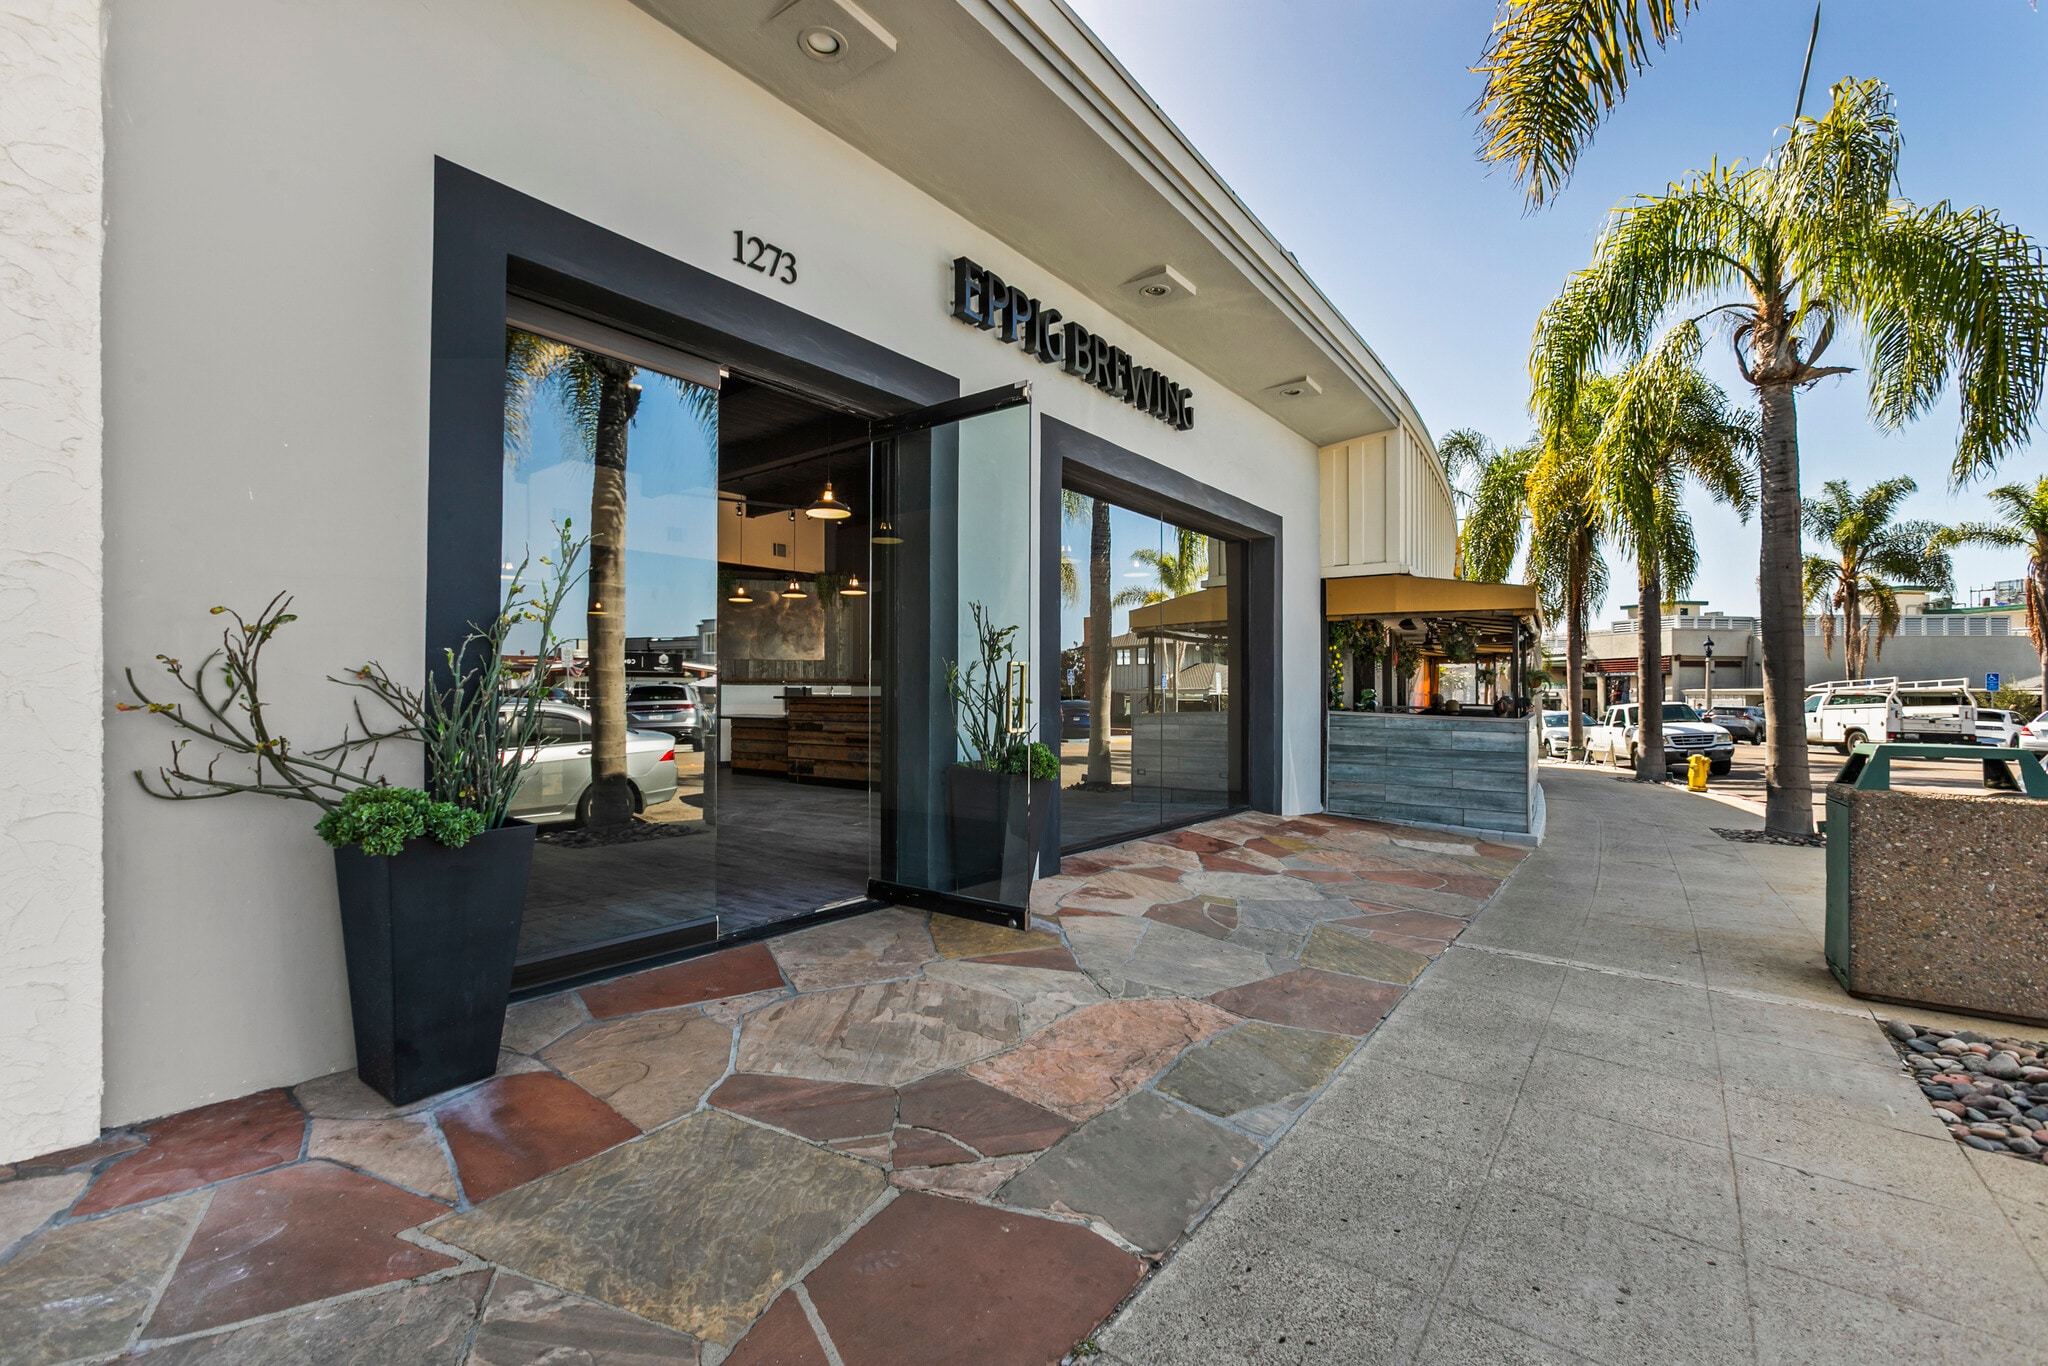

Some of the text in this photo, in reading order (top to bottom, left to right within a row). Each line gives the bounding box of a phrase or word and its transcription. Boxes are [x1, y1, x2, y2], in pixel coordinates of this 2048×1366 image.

[732, 230, 797, 285] 1273
[953, 256, 1195, 431] EPPIG BREWING
